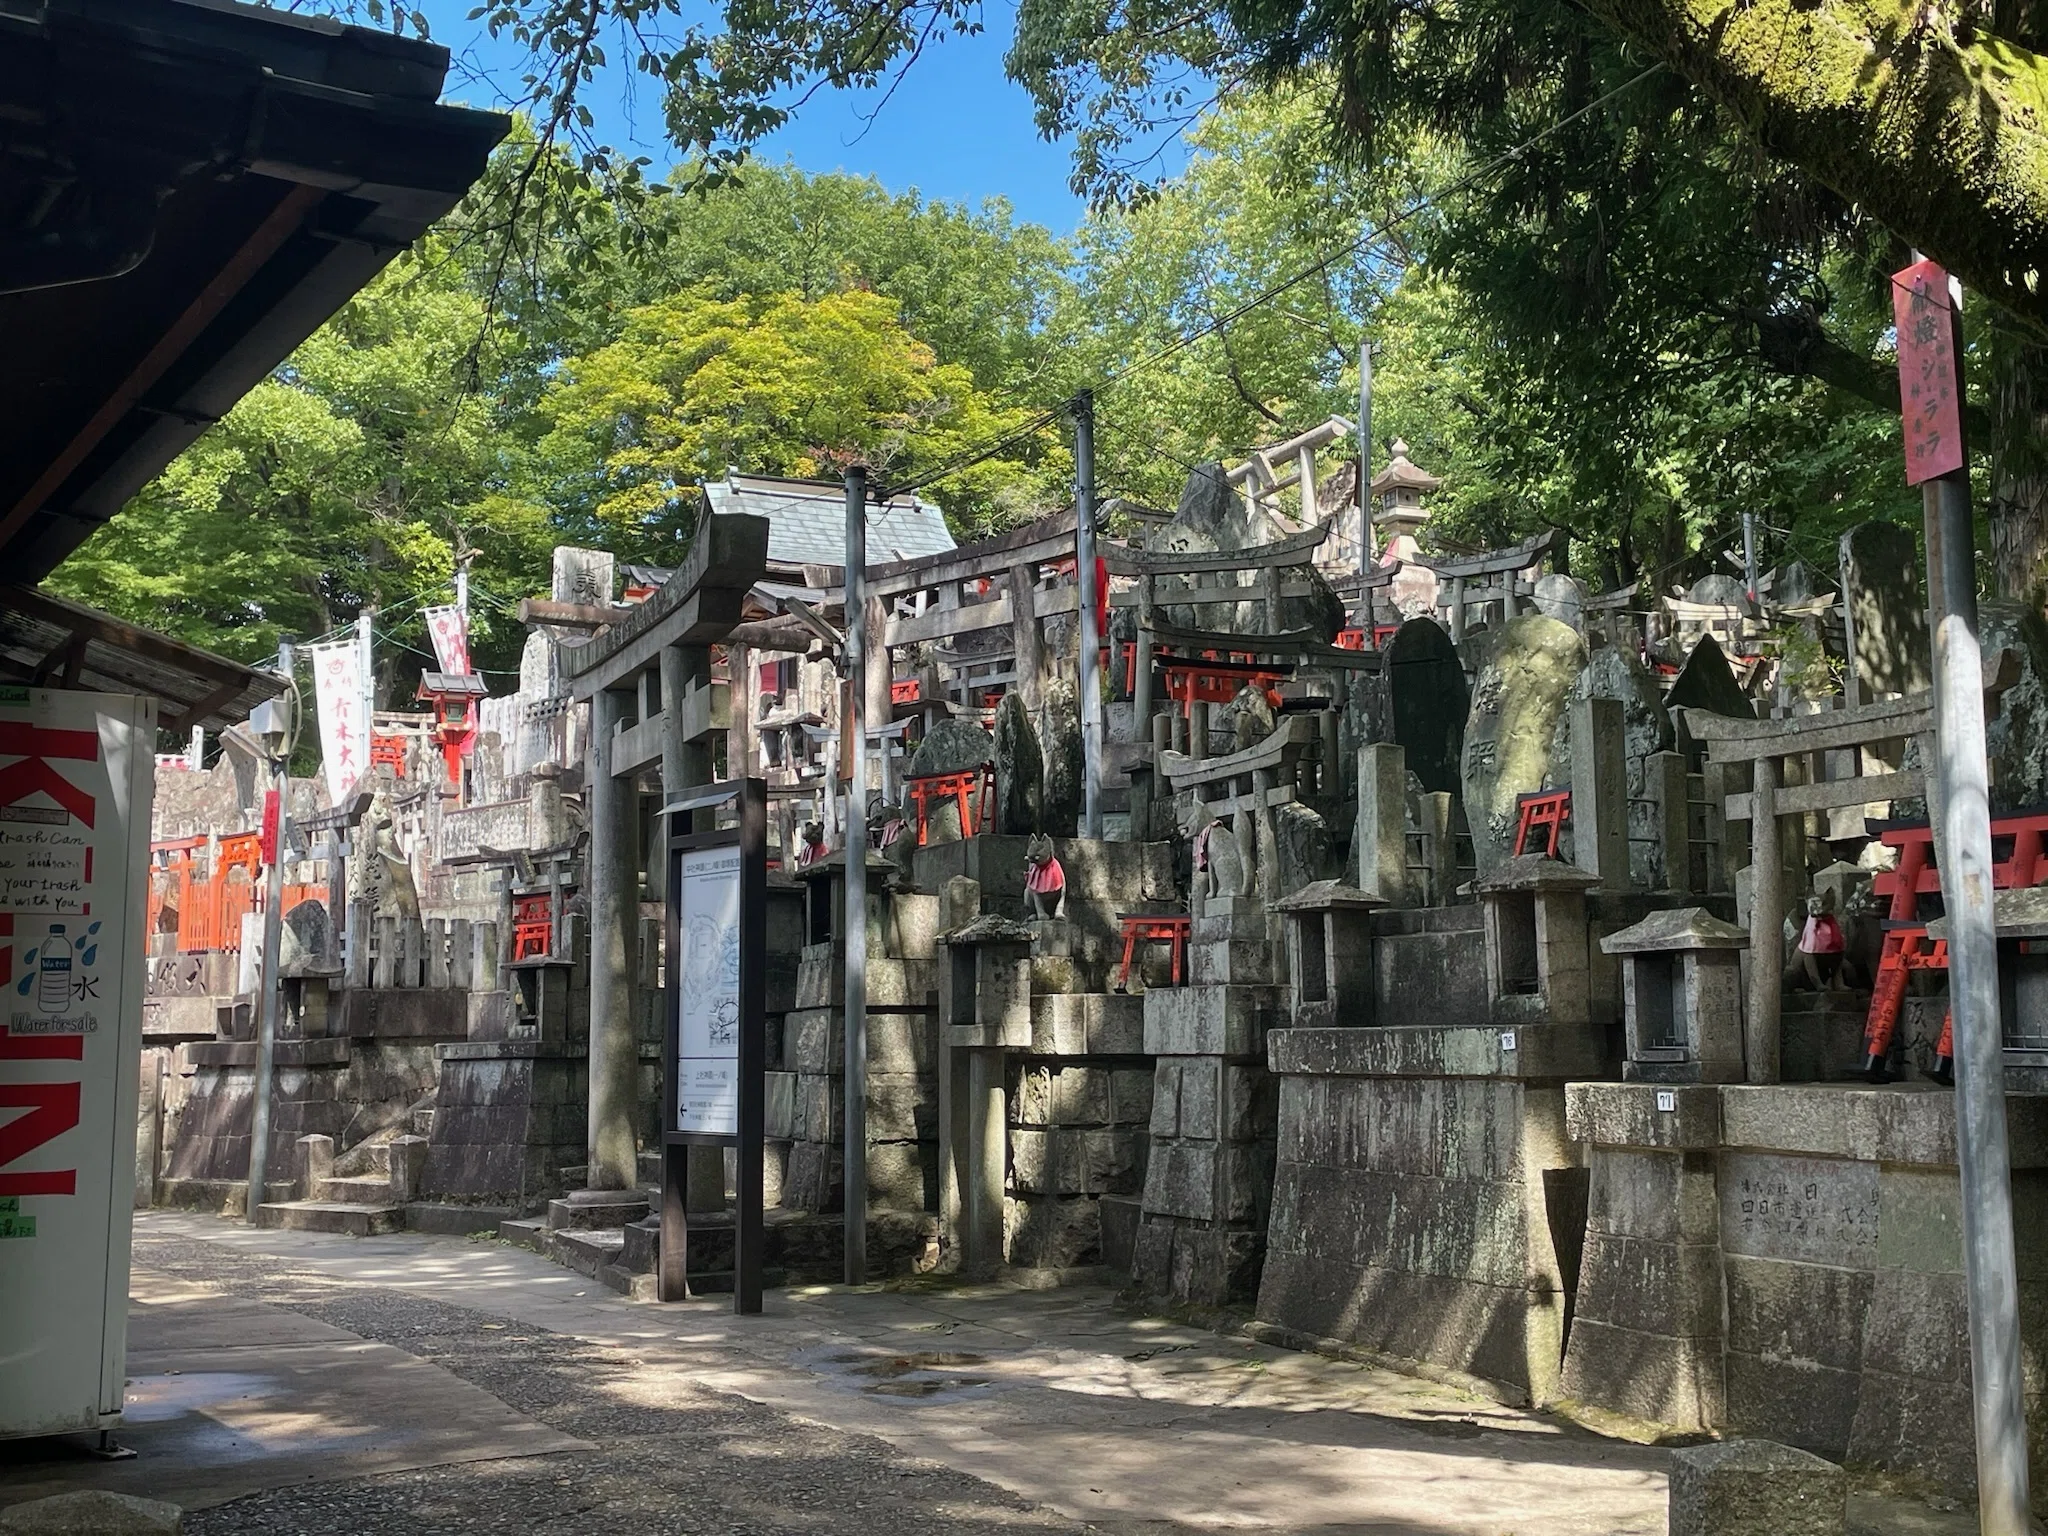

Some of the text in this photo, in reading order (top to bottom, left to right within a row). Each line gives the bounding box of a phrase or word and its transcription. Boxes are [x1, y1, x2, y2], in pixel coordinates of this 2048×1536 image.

[50, 831, 85, 845] Can
[4, 878, 82, 893] your trash
[14, 894, 49, 906] with
[55, 896, 79, 912] you
[41, 959, 71, 970] Water
[71, 976, 101, 1002] 水
[11, 1011, 49, 1034] Water
[1503, 1035, 1513, 1048] 76
[1659, 1094, 1671, 1109] 77
